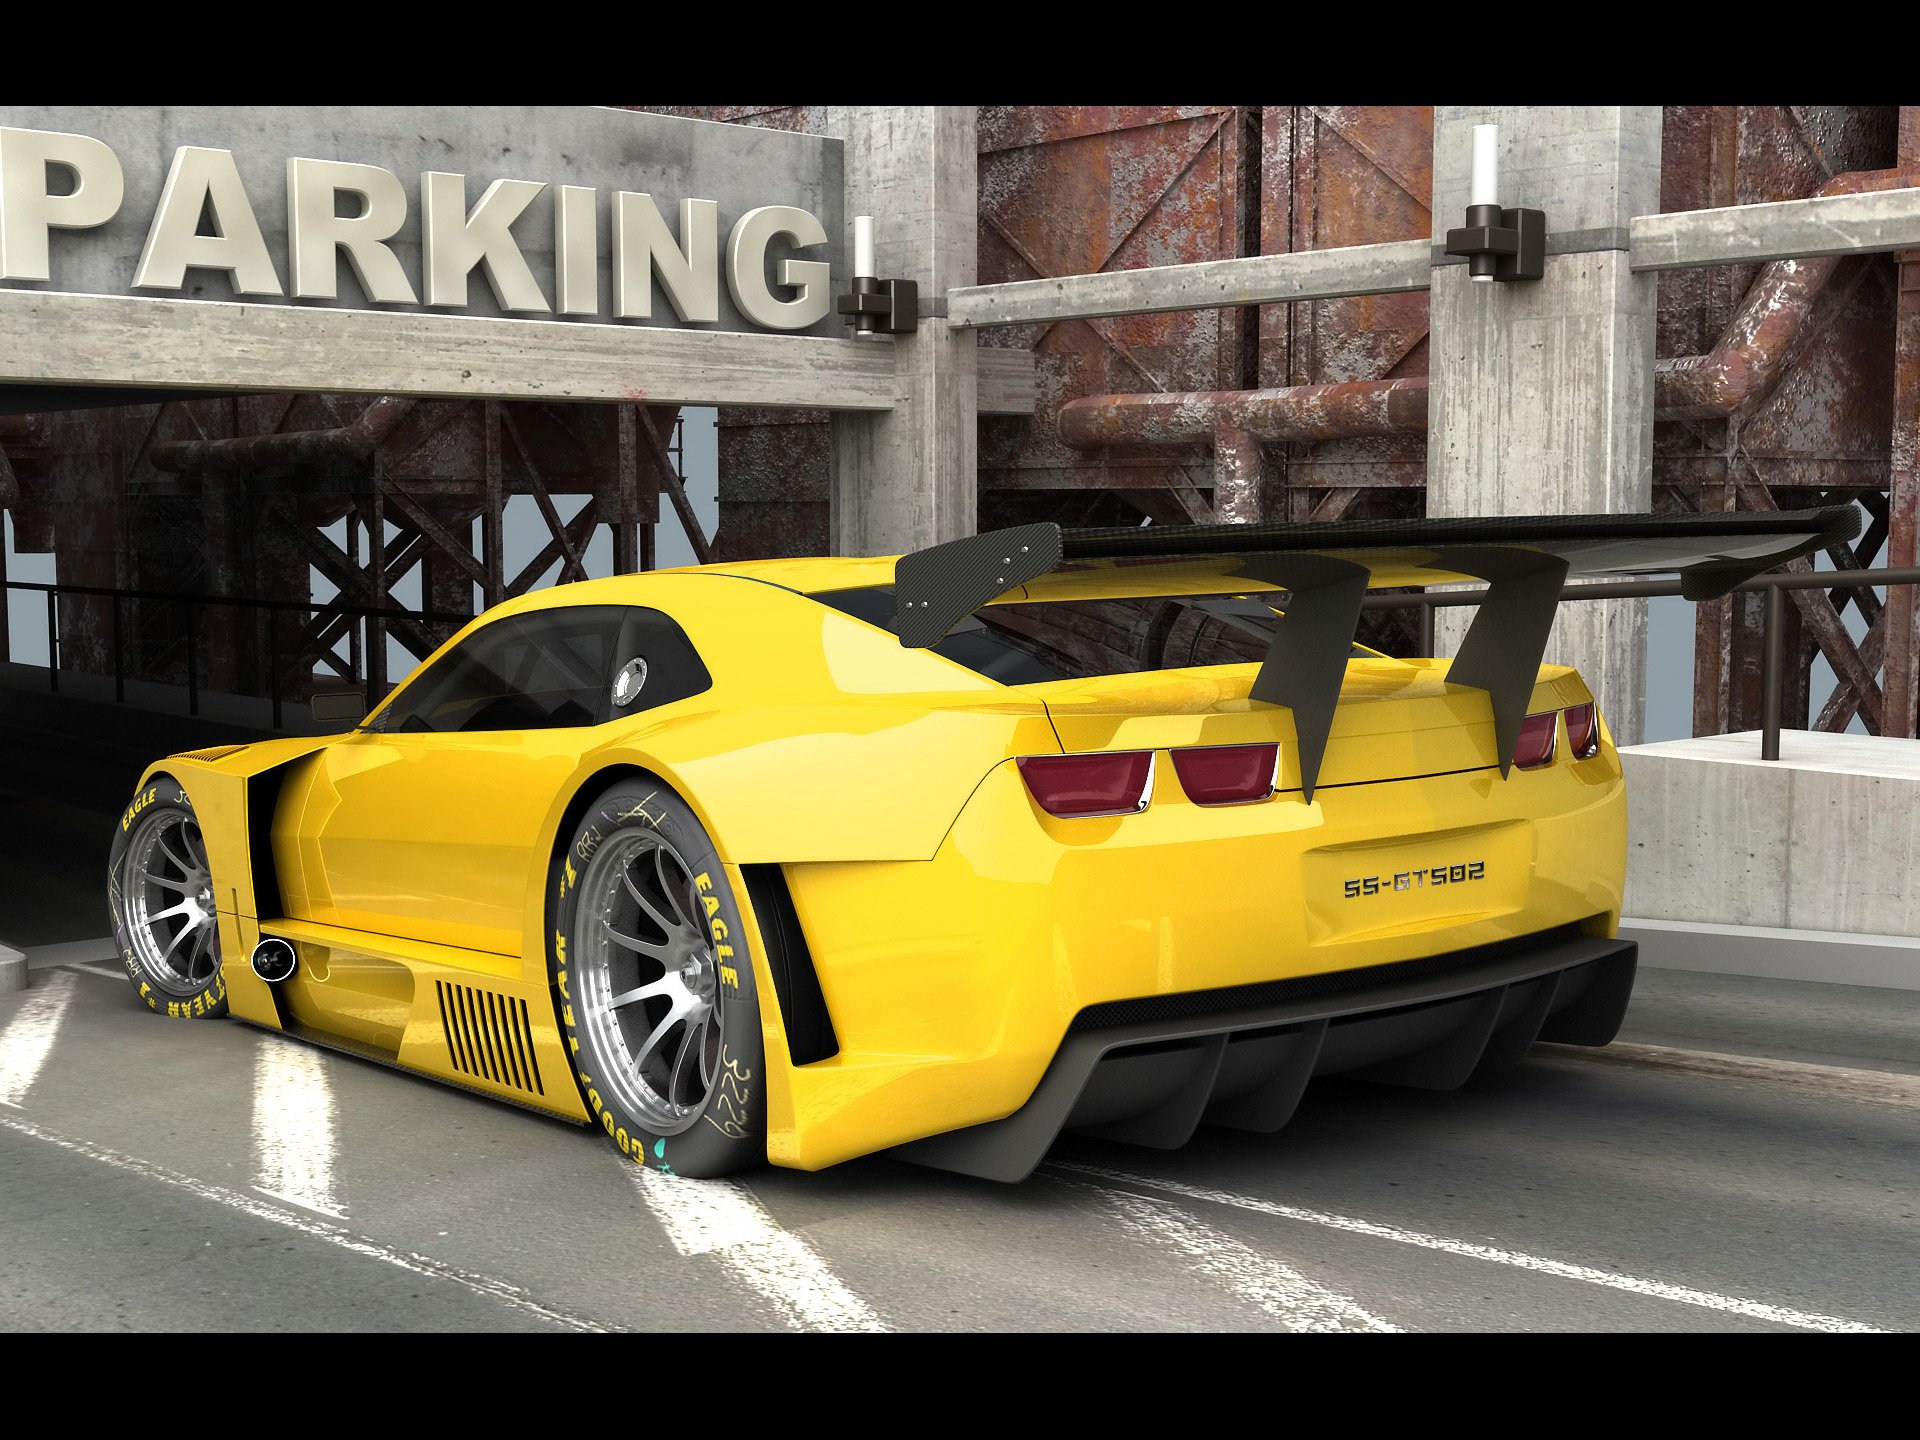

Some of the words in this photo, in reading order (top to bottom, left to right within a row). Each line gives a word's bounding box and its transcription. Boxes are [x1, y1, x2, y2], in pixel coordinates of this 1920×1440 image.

[0, 126, 830, 329] PARKING
[123, 787, 157, 833] EAGLE
[694, 872, 739, 991] EAGLE
